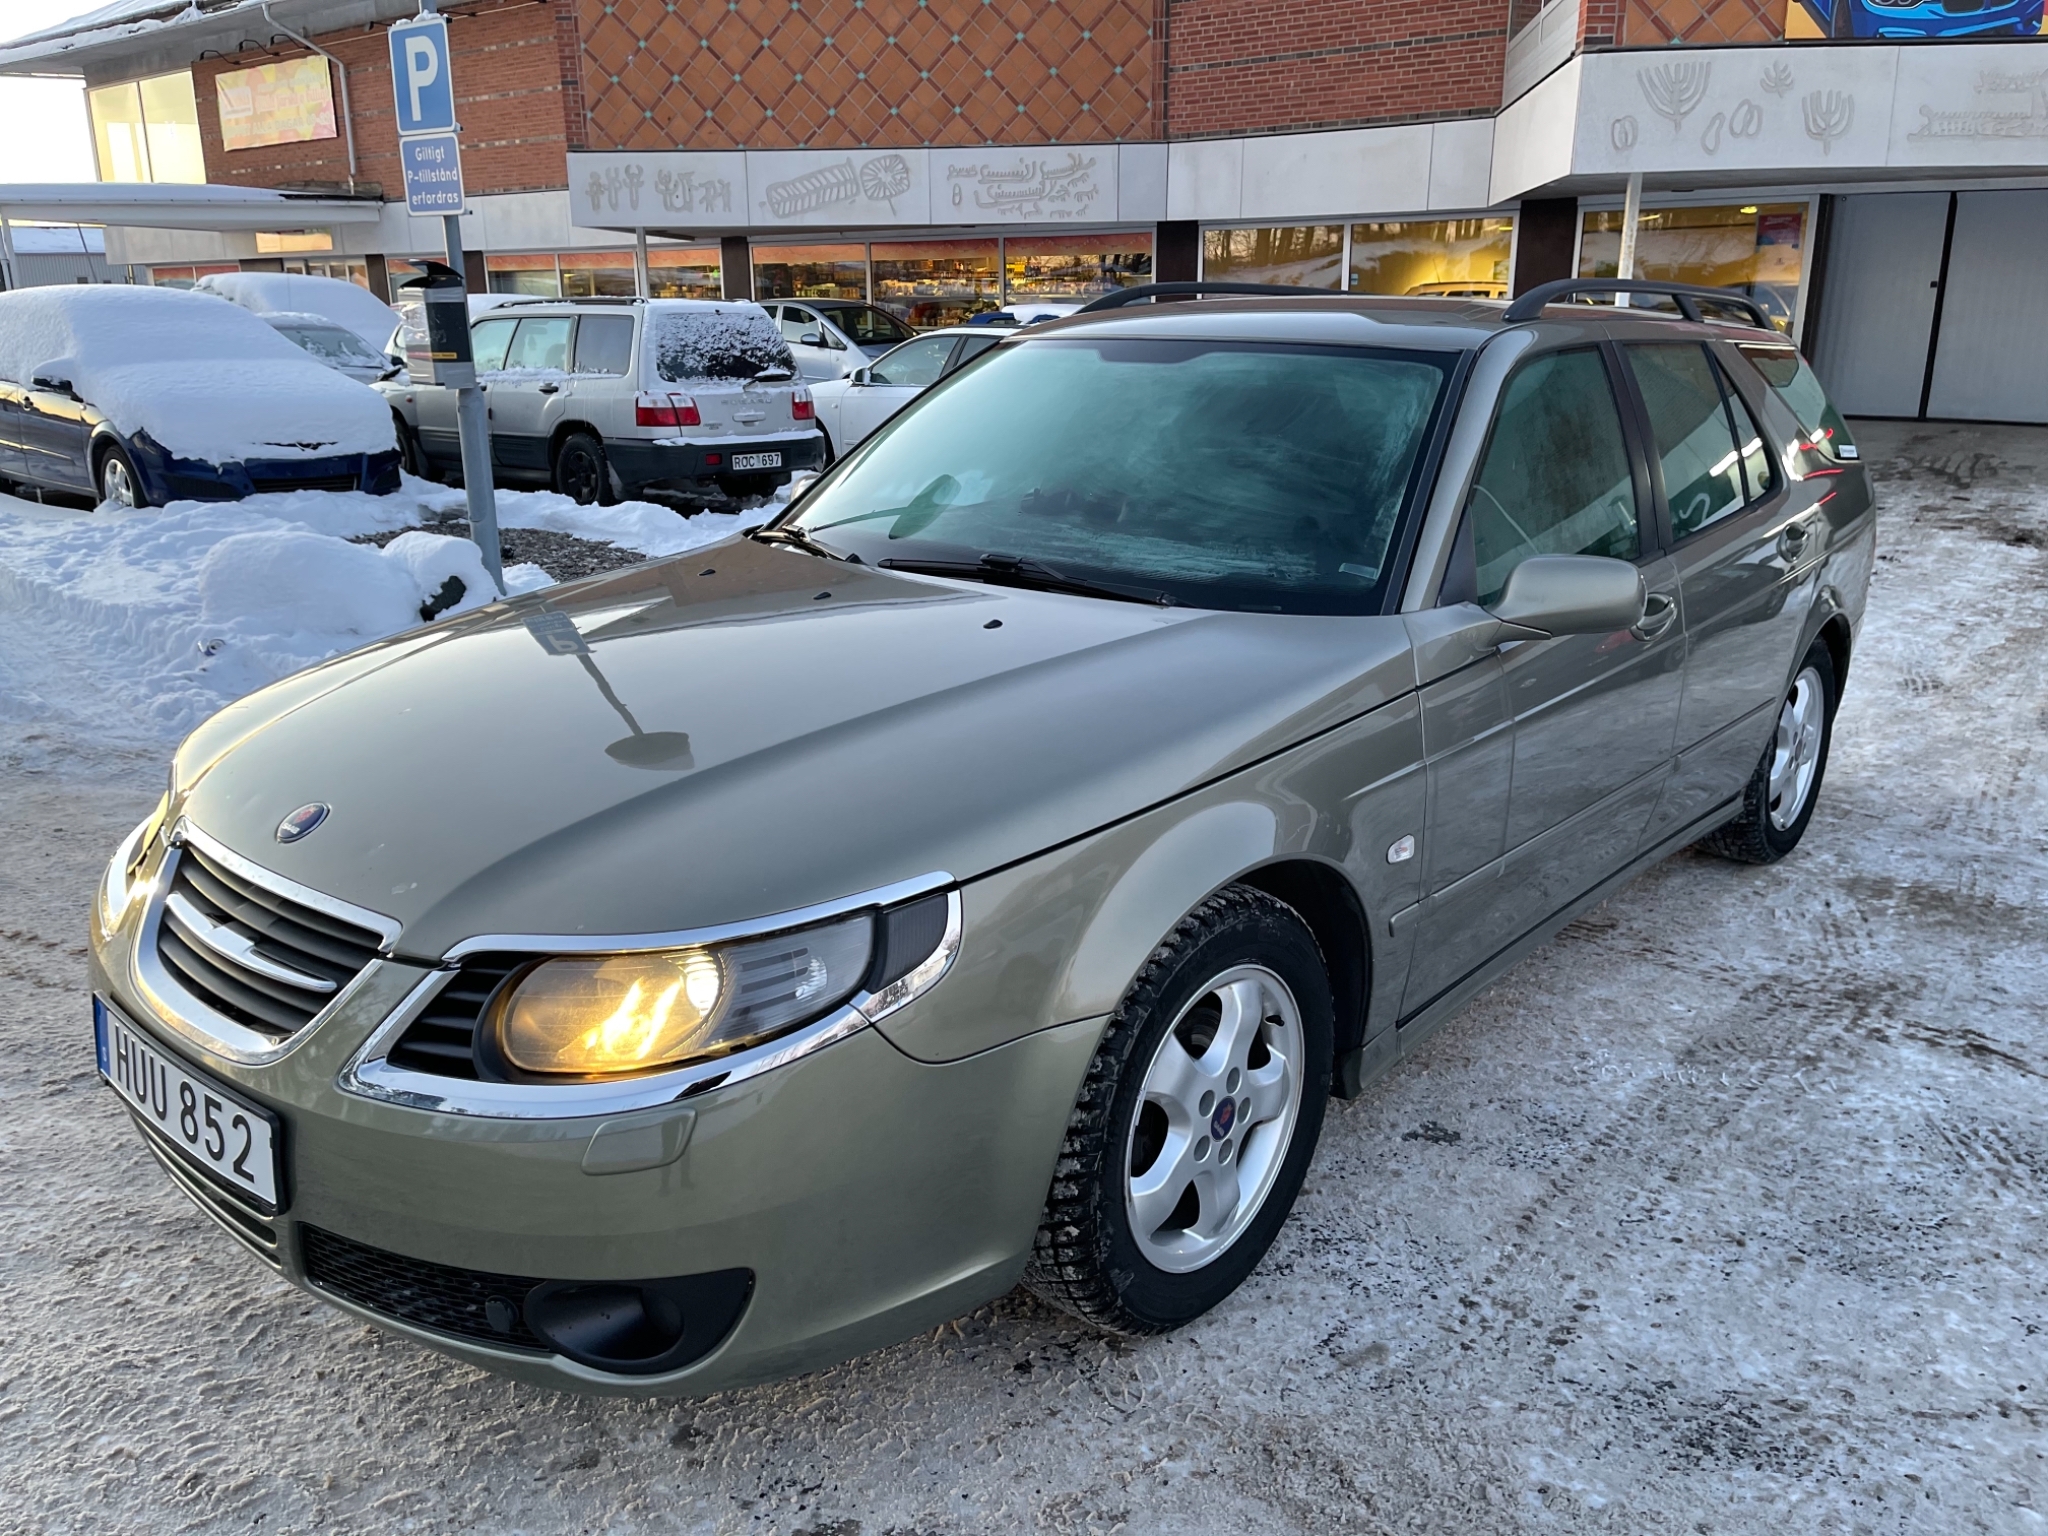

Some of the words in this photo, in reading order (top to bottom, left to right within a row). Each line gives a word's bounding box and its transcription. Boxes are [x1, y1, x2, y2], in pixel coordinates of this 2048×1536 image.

[405, 35, 438, 121] P
[415, 146, 445, 163] Giltigt
[408, 167, 458, 184] P-tillstånd
[412, 190, 459, 206] erfordras
[734, 456, 755, 469] ROC
[762, 454, 780, 466] 697
[114, 1023, 167, 1121] HUU
[180, 1079, 255, 1183] 852
